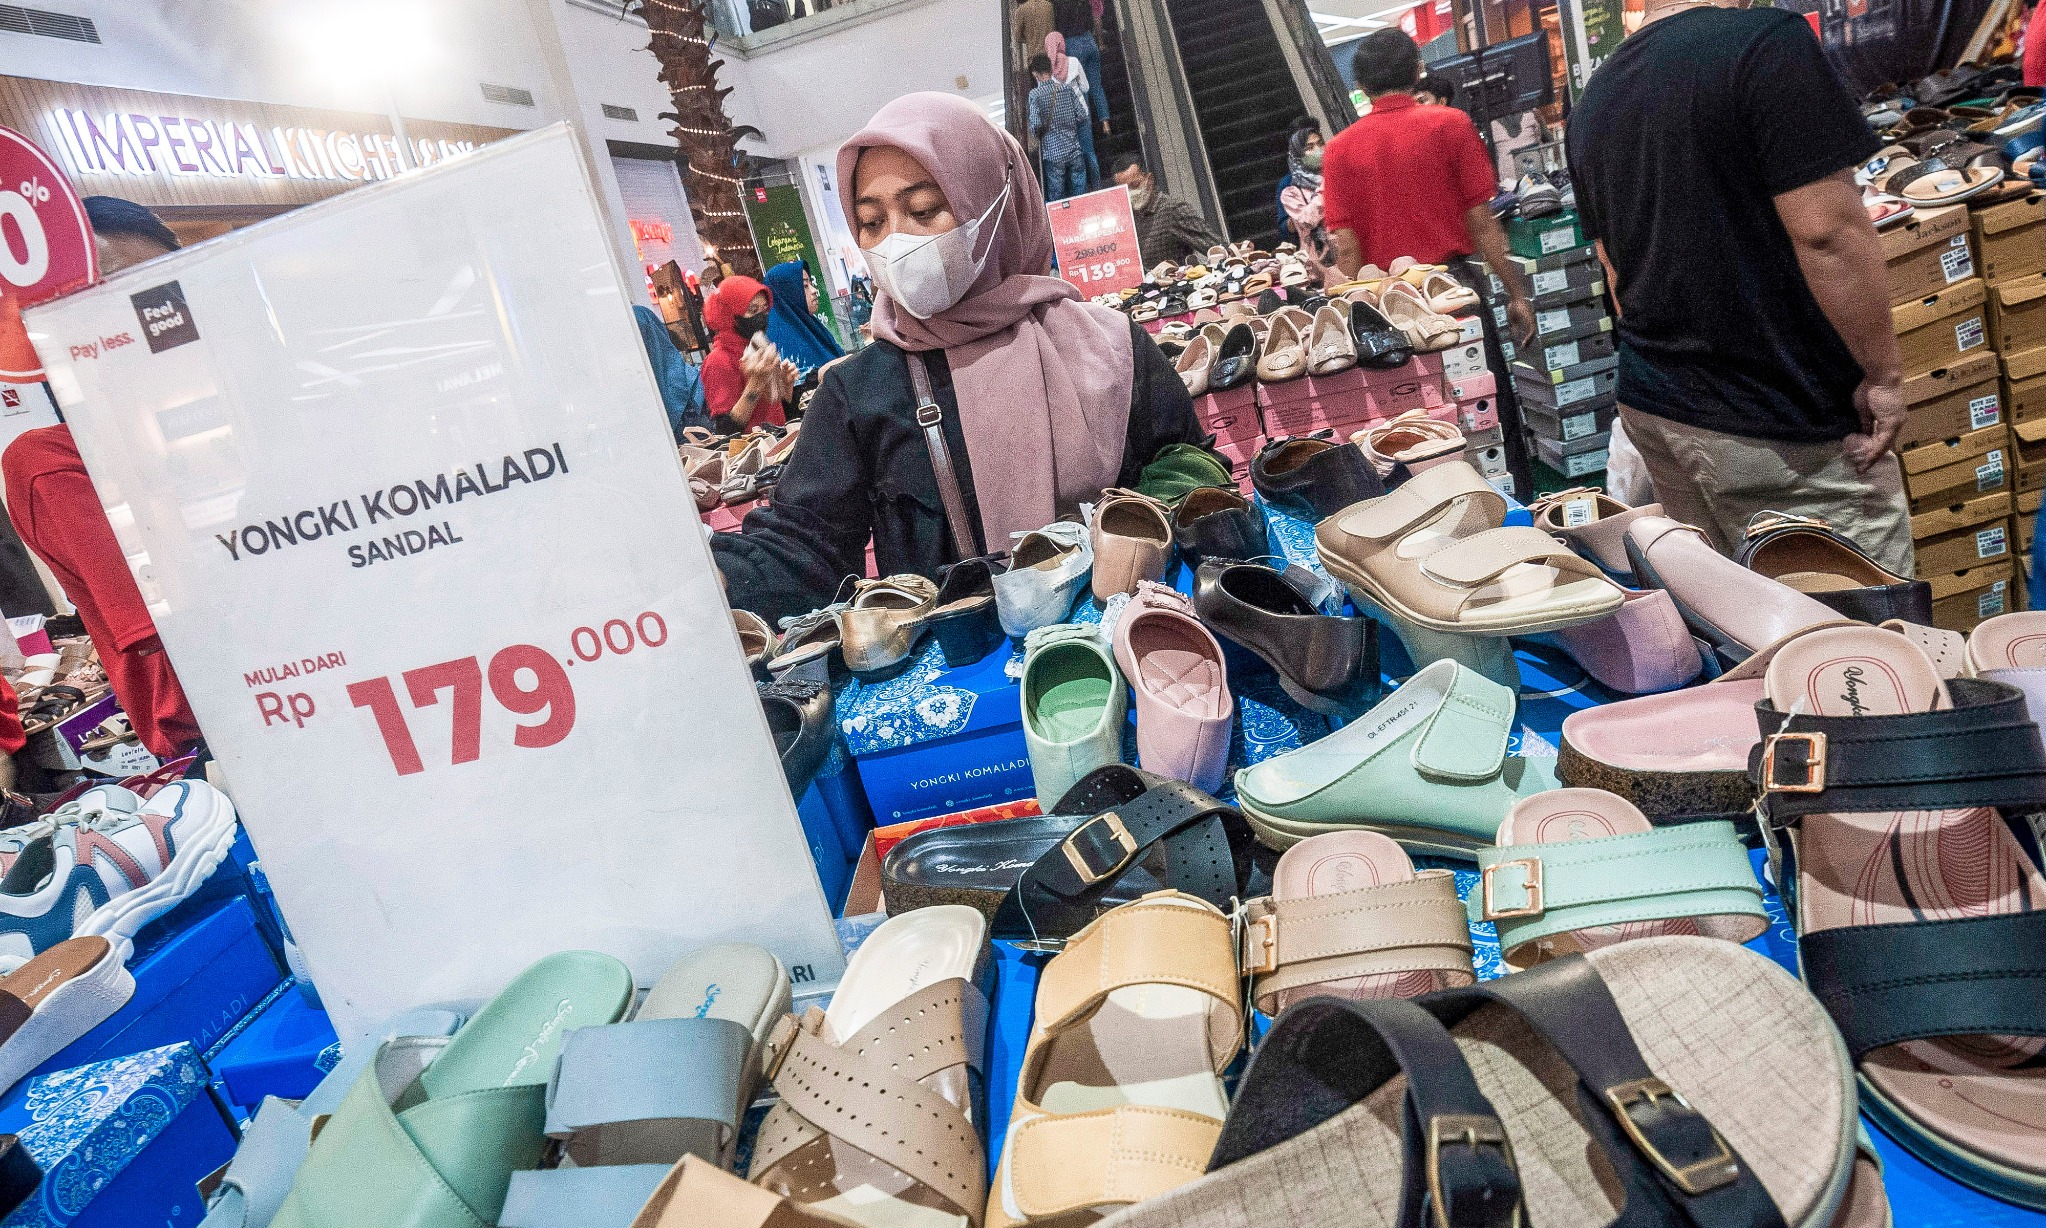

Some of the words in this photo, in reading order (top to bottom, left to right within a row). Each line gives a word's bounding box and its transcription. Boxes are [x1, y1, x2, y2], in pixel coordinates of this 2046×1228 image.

[54, 107, 286, 179] IMPERIAL
[142, 300, 174, 321] Feel
[148, 311, 185, 337] good
[69, 342, 98, 361] Pay
[216, 500, 359, 562] YONGKI
[360, 442, 570, 526] KOMALADI
[347, 521, 464, 569] SANDAL
[243, 661, 301, 689] MULAI
[301, 650, 347, 674] DARI
[254, 690, 317, 729] Rp
[910, 772, 961, 790] YONGKI
[964, 757, 1031, 779] KOMALADI
